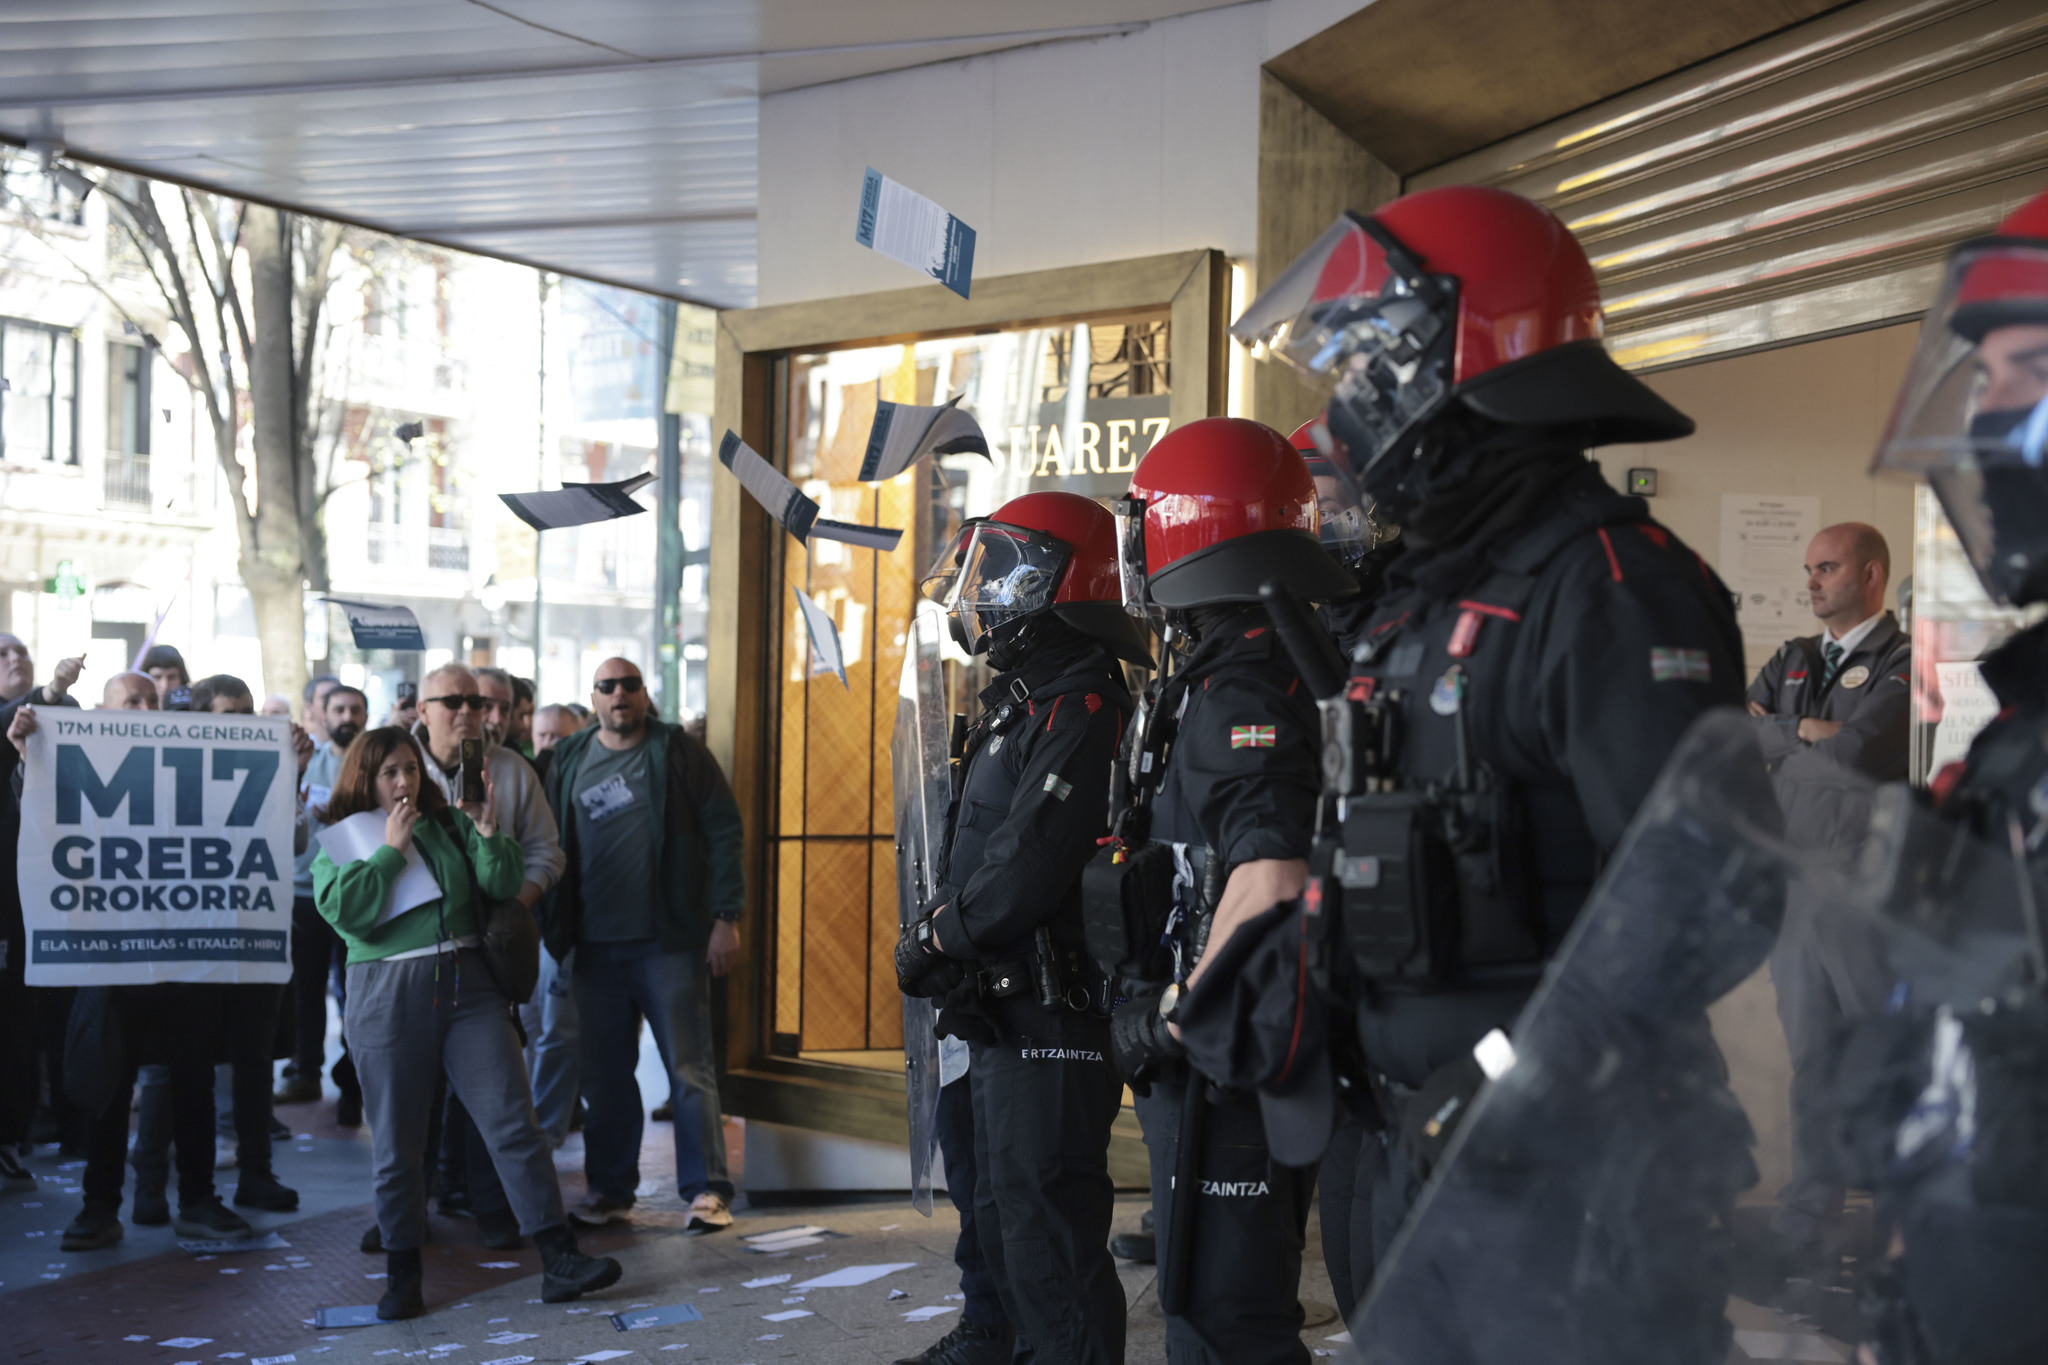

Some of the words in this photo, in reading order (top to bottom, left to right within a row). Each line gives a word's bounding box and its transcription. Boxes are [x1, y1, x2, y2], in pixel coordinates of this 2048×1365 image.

[57, 721, 93, 735] 17M
[100, 723, 181, 738] HUELGA
[187, 725, 278, 742] GENERAL
[55, 744, 280, 827] M17
[52, 835, 279, 881] GREBA
[50, 884, 275, 912] OROKORRA
[40, 939, 69, 952] ELA
[81, 939, 109, 951] LAB
[120, 938, 177, 951] STEILAS
[187, 938, 246, 951] ETXALDE
[254, 938, 282, 950] HIRU
[1021, 1048, 1103, 1062] ERTZAINTZA
[1171, 1175, 1269, 1197] ZAINTZA
